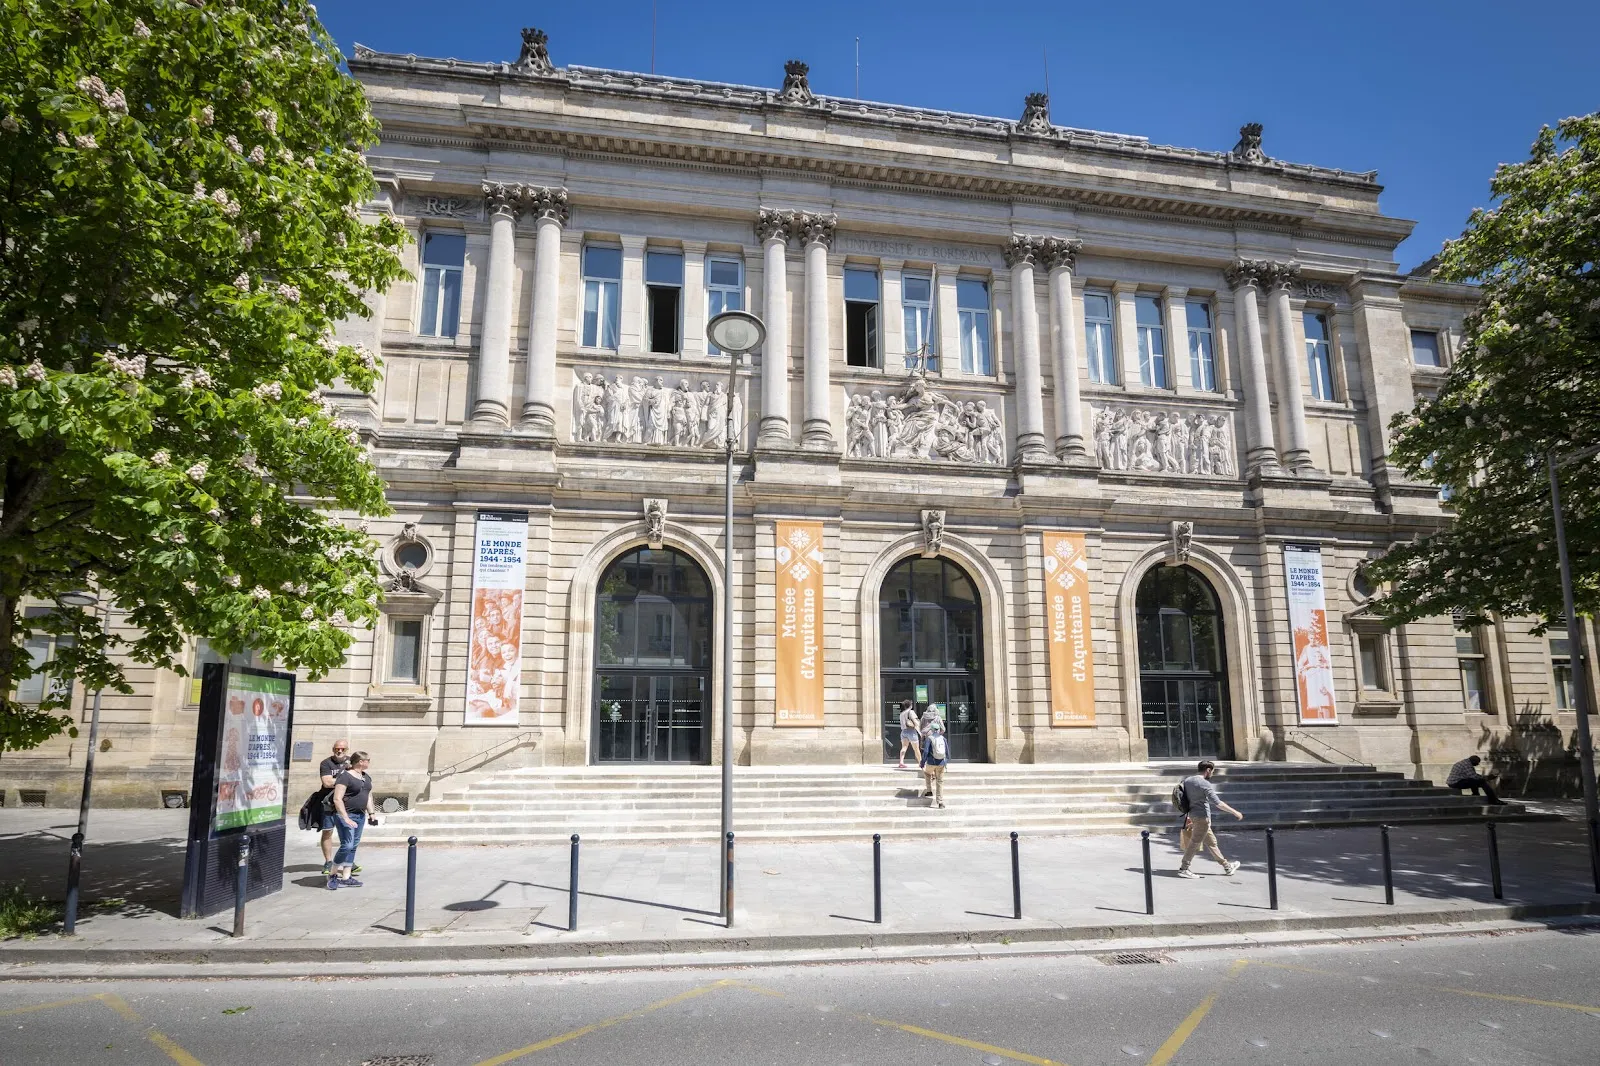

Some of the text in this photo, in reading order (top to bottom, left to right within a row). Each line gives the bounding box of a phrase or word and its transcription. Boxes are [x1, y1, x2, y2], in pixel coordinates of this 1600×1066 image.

[932, 246, 991, 263] BORDEAUX
[493, 540, 522, 548] MONDE
[782, 588, 796, 638] Musée
[800, 588, 818, 680] d'Aquitaine
[1052, 595, 1066, 643] Musée
[1069, 595, 1088, 682] d'Aquitaine
